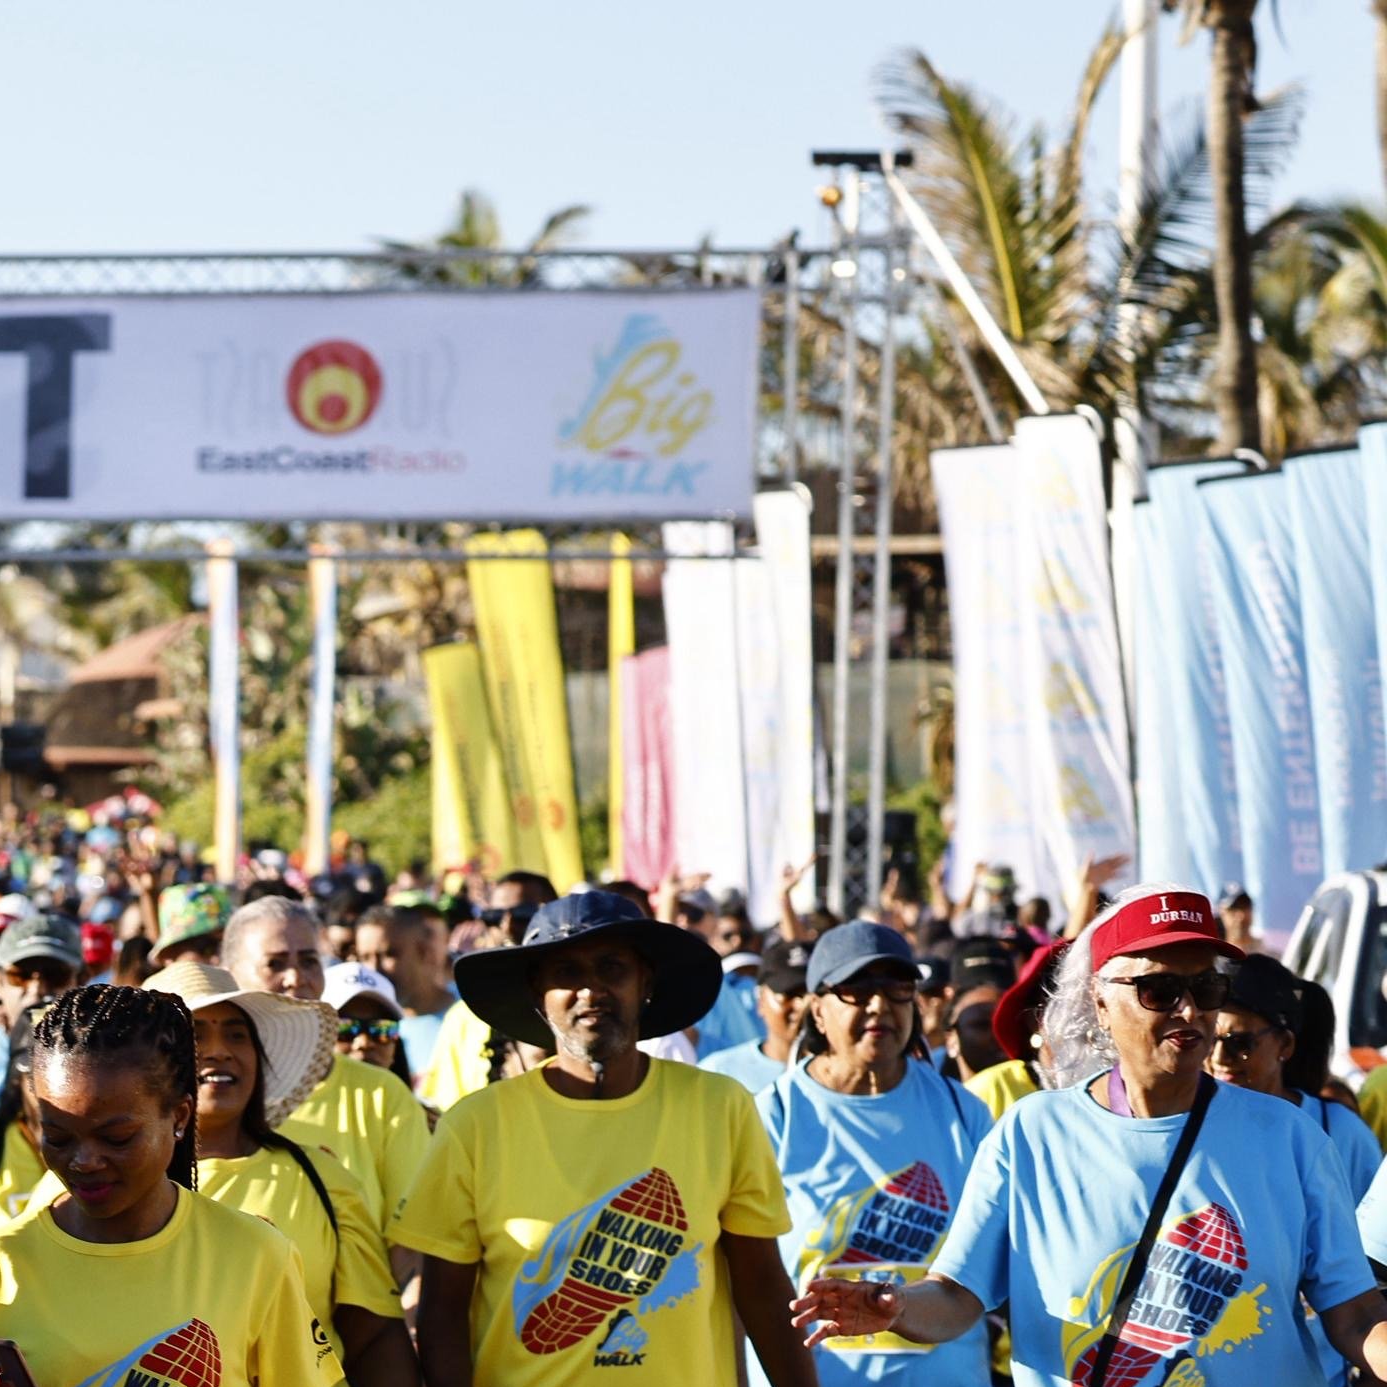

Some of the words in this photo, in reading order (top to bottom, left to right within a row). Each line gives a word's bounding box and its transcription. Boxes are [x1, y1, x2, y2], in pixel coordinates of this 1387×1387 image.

[559, 339, 713, 457] Big
[197, 446, 466, 474] EastCoastRadio
[550, 460, 709, 496] WALK
[1150, 910, 1203, 924] DURBAN
[859, 1209, 880, 1231] IN
[883, 1217, 936, 1254] YOUR
[872, 1192, 948, 1233] WALKING
[596, 1209, 684, 1256] WALKING
[850, 1232, 925, 1262] SHOES
[579, 1231, 608, 1262] IN
[607, 1242, 667, 1281] YOUR
[1149, 1244, 1243, 1297] WALKING
[569, 1259, 653, 1296] SHOES
[1128, 1301, 1209, 1336] SHOES
[1163, 1277, 1225, 1322] YOUR
[594, 1353, 646, 1367] WALK
